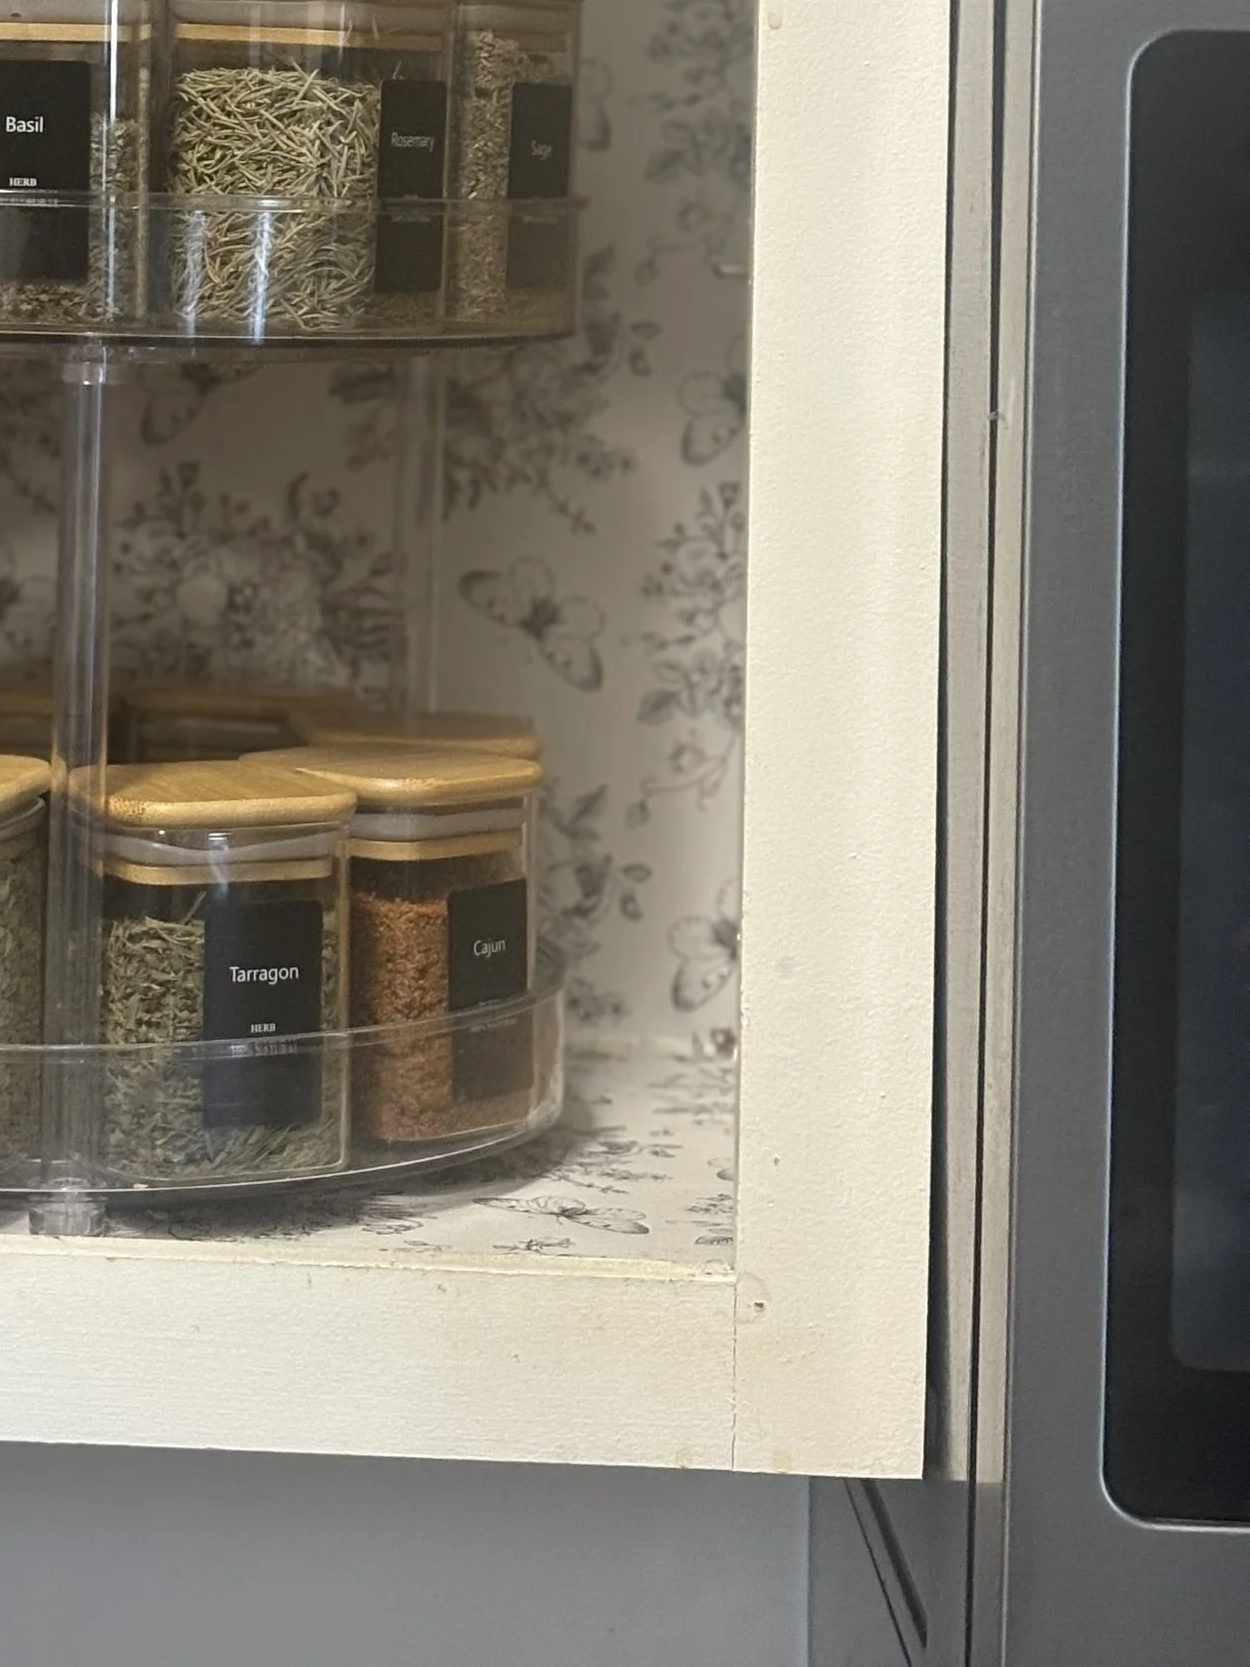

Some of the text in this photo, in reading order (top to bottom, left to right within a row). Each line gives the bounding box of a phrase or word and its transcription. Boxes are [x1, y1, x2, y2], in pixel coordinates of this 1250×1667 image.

[5, 116, 44, 133] Basil
[391, 132, 435, 153] Rosemary
[9, 177, 37, 186] HERB
[473, 938, 506, 958] Cajun
[229, 966, 299, 985] Tarragon
[250, 1023, 276, 1033] HERB
